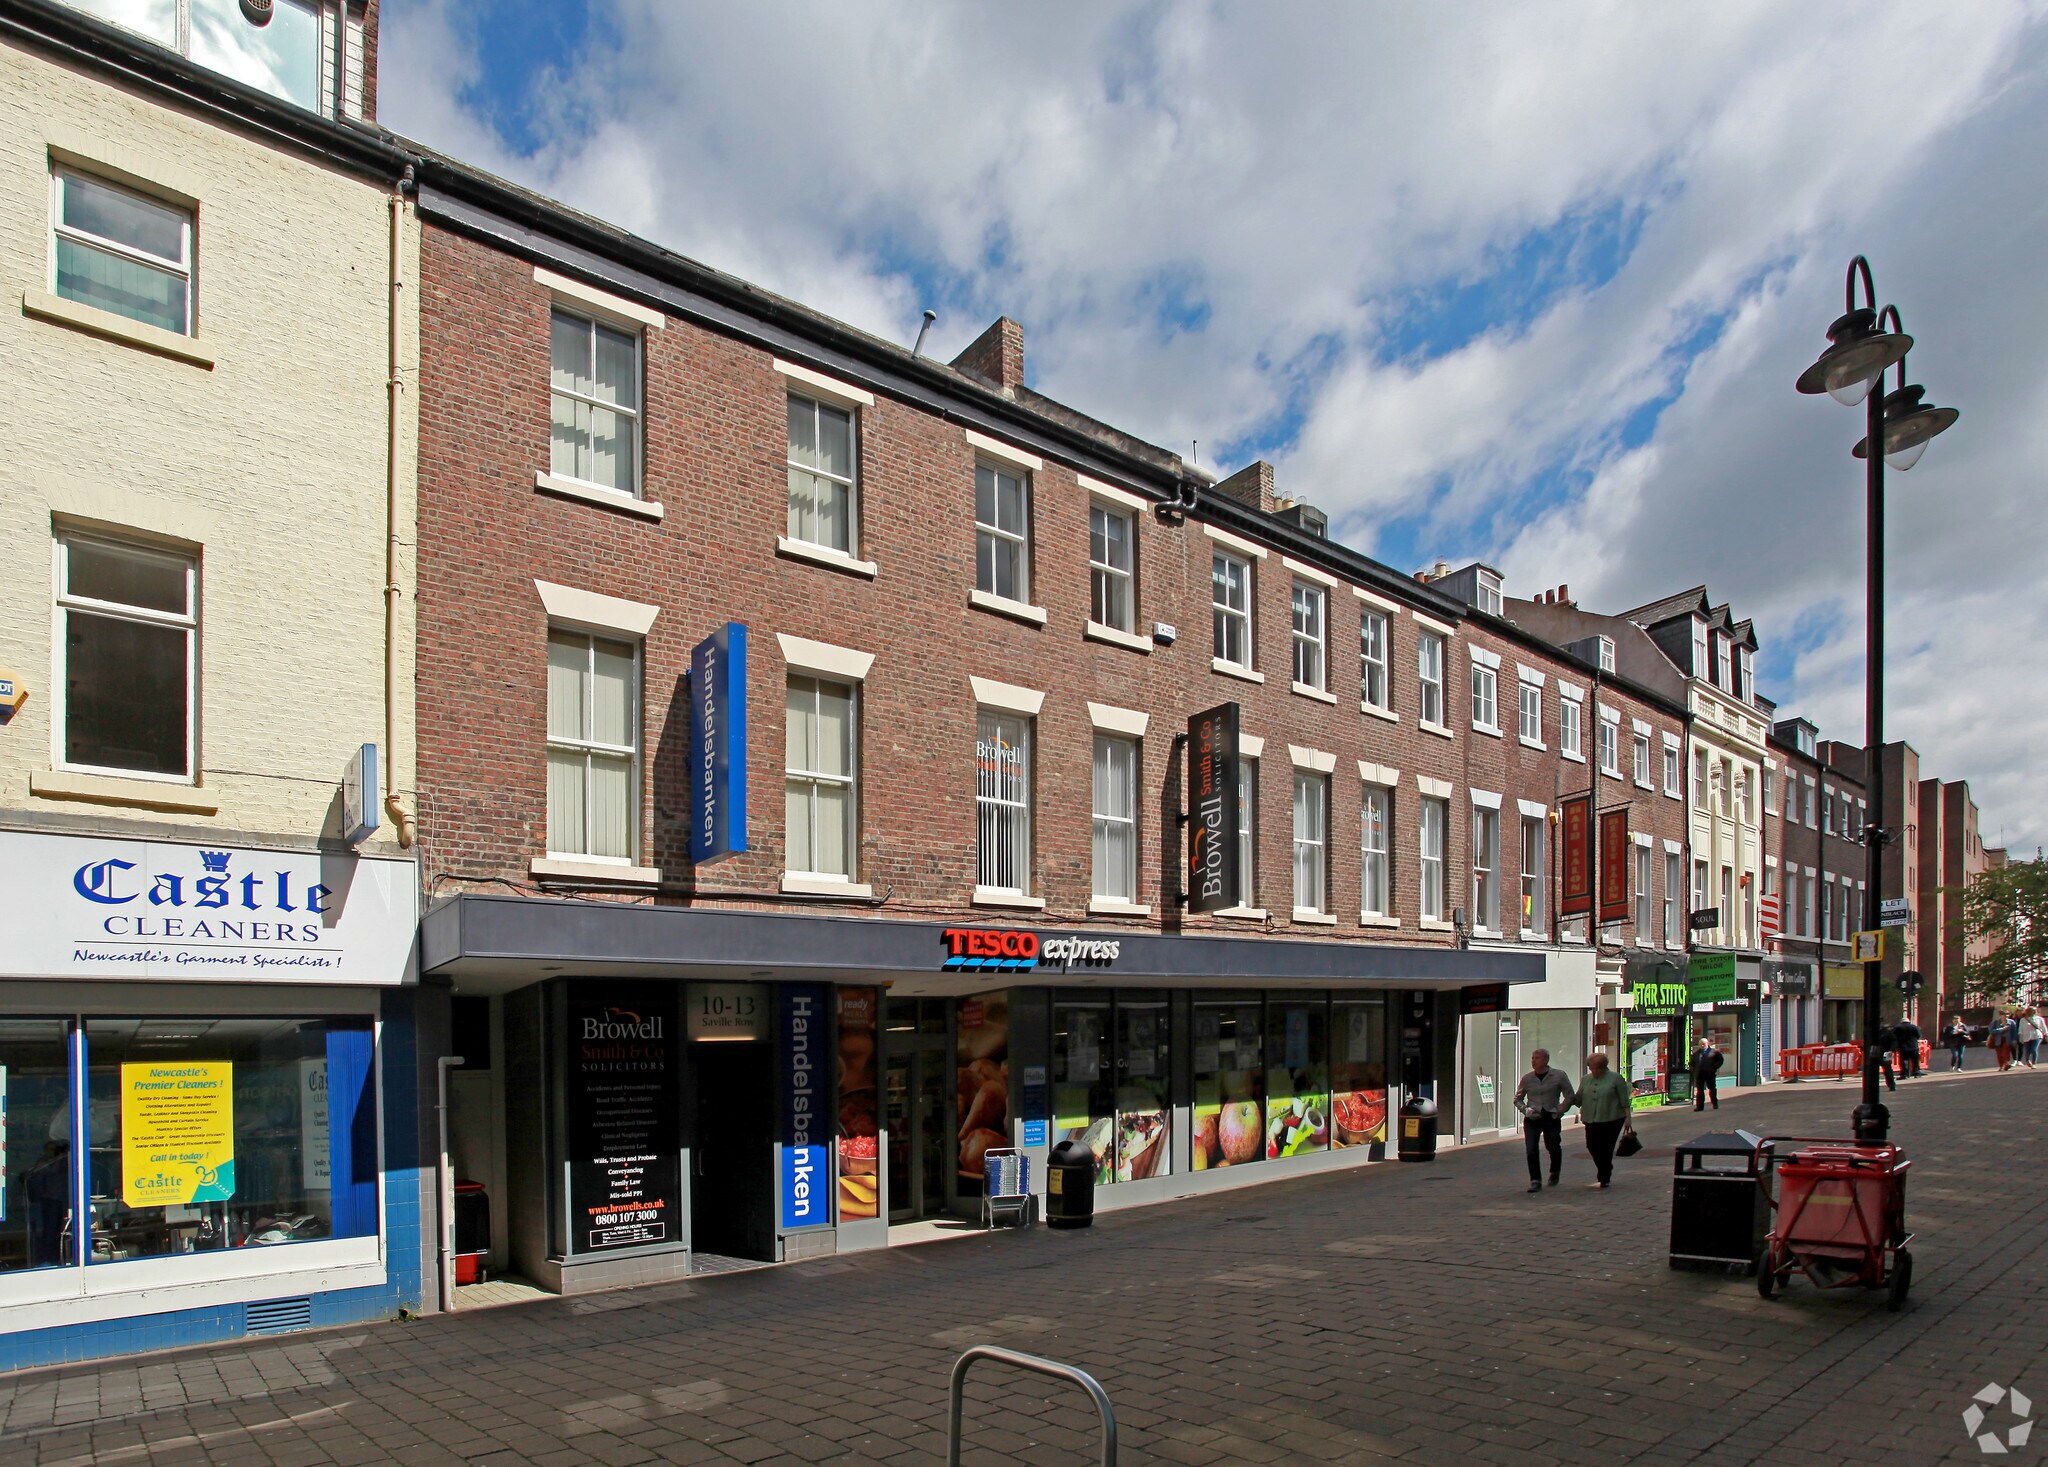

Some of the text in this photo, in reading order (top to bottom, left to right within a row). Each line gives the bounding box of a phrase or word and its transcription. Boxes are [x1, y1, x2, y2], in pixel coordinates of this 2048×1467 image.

[704, 647, 715, 847] Handelsbanken
[1201, 720, 1211, 796] Smith & Co
[1201, 795, 1222, 899] Browell
[1569, 848, 1581, 892] SALON
[73, 858, 333, 914] Castle
[1695, 915, 1715, 924] SOUL
[103, 915, 320, 942] CLEANERS
[944, 929, 1119, 967] TESCO express
[73, 949, 171, 963] Newcastle's
[176, 951, 249, 967] Garment
[253, 955, 331, 969] Specialists
[1709, 955, 1733, 963] STITCH
[1632, 983, 1658, 1007] STAR
[703, 996, 755, 1015] 10-13
[844, 998, 868, 1011] ready
[582, 1016, 664, 1039] Browell
[702, 1017, 754, 1027] Saville Row
[581, 1043, 626, 1060] Smith
[644, 1044, 664, 1059] Co
[149, 1067, 208, 1077] Newcastle's
[581, 1062, 665, 1072] SOLICITORS
[1025, 1071, 1045, 1081] Hello
[134, 1080, 175, 1090] Premier
[177, 1080, 217, 1089] Cleaners
[792, 996, 814, 1218] Handelsbanken
[150, 1154, 167, 1162] Call
[169, 1153, 177, 1161] in
[180, 1152, 204, 1160] today
[607, 1167, 644, 1175] Conveyancing
[135, 1176, 183, 1189] Castle
[140, 1188, 180, 1196] CLEANERS
[610, 1191, 633, 1199] Mis-sold
[588, 1198, 665, 1215] www.browells.co.uk
[595, 1209, 657, 1226] 0800 107 3000
